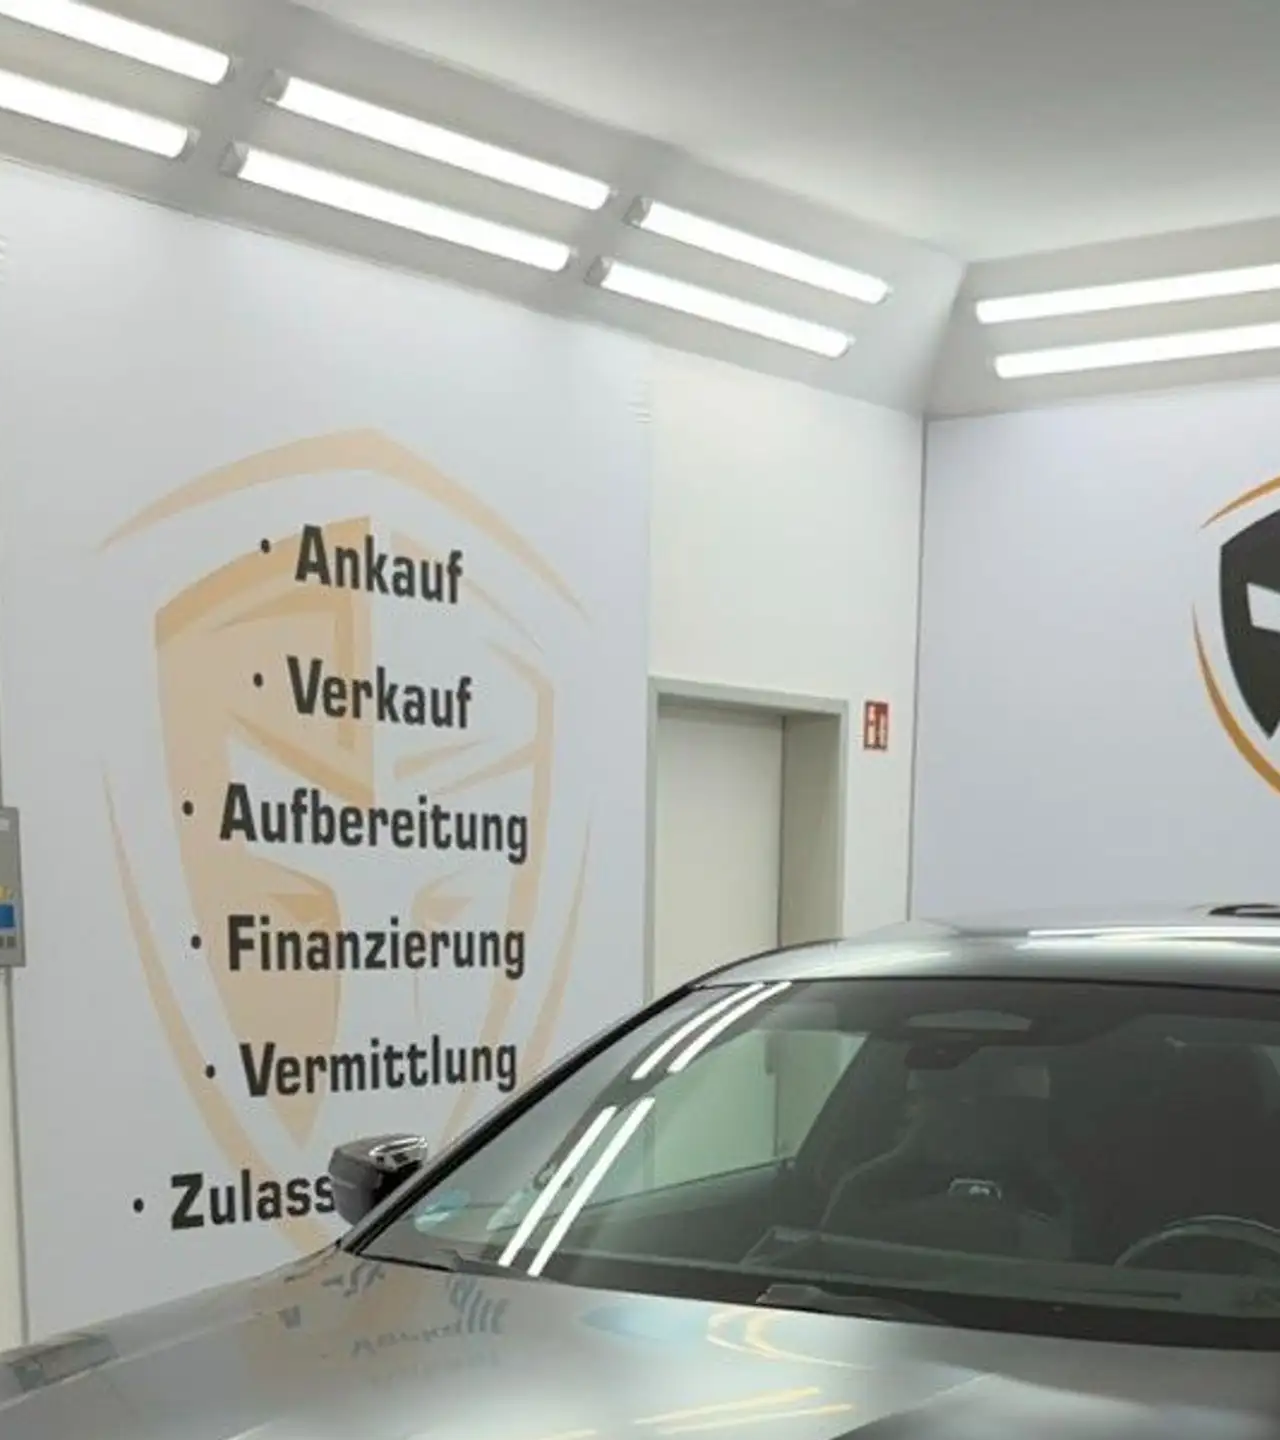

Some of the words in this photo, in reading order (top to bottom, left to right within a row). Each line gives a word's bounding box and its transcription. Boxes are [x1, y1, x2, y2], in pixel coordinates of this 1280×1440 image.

[294, 524, 464, 604] Ankauf
[286, 656, 473, 729] Verkauf
[219, 783, 529, 865] Aufbereitung
[228, 914, 526, 980] Finanzierung
[239, 1034, 518, 1098] Vermittlung
[171, 1168, 336, 1231] Zulass
